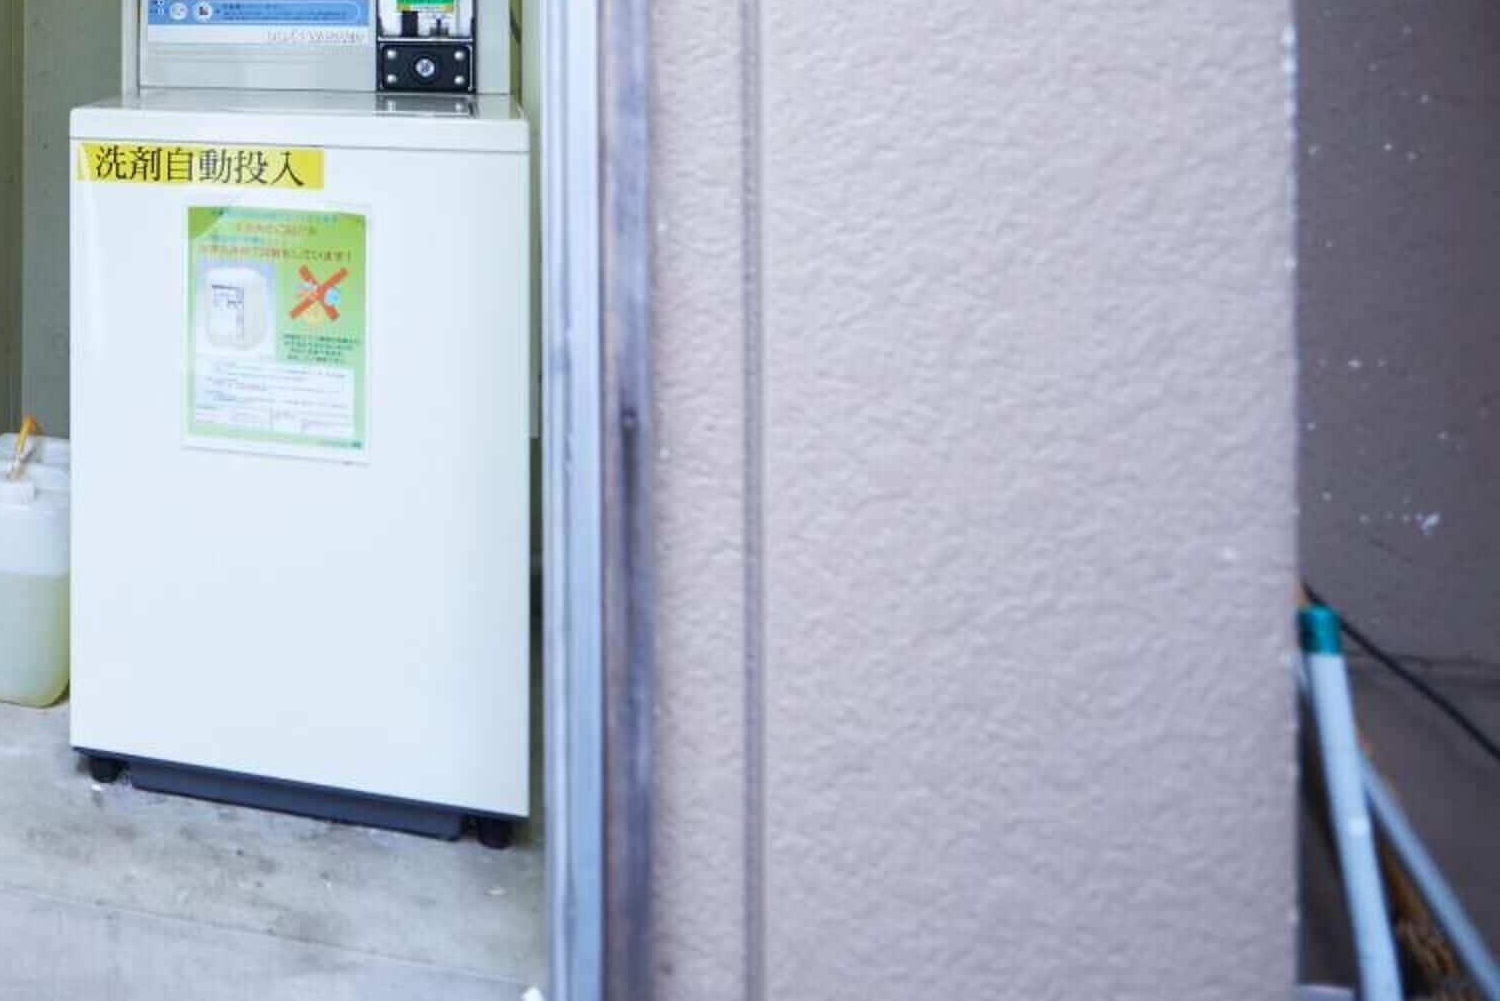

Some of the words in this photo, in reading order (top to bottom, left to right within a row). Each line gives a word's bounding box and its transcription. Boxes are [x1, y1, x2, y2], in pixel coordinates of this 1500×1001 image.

[94, 144, 306, 188] 洗剤自動投入
